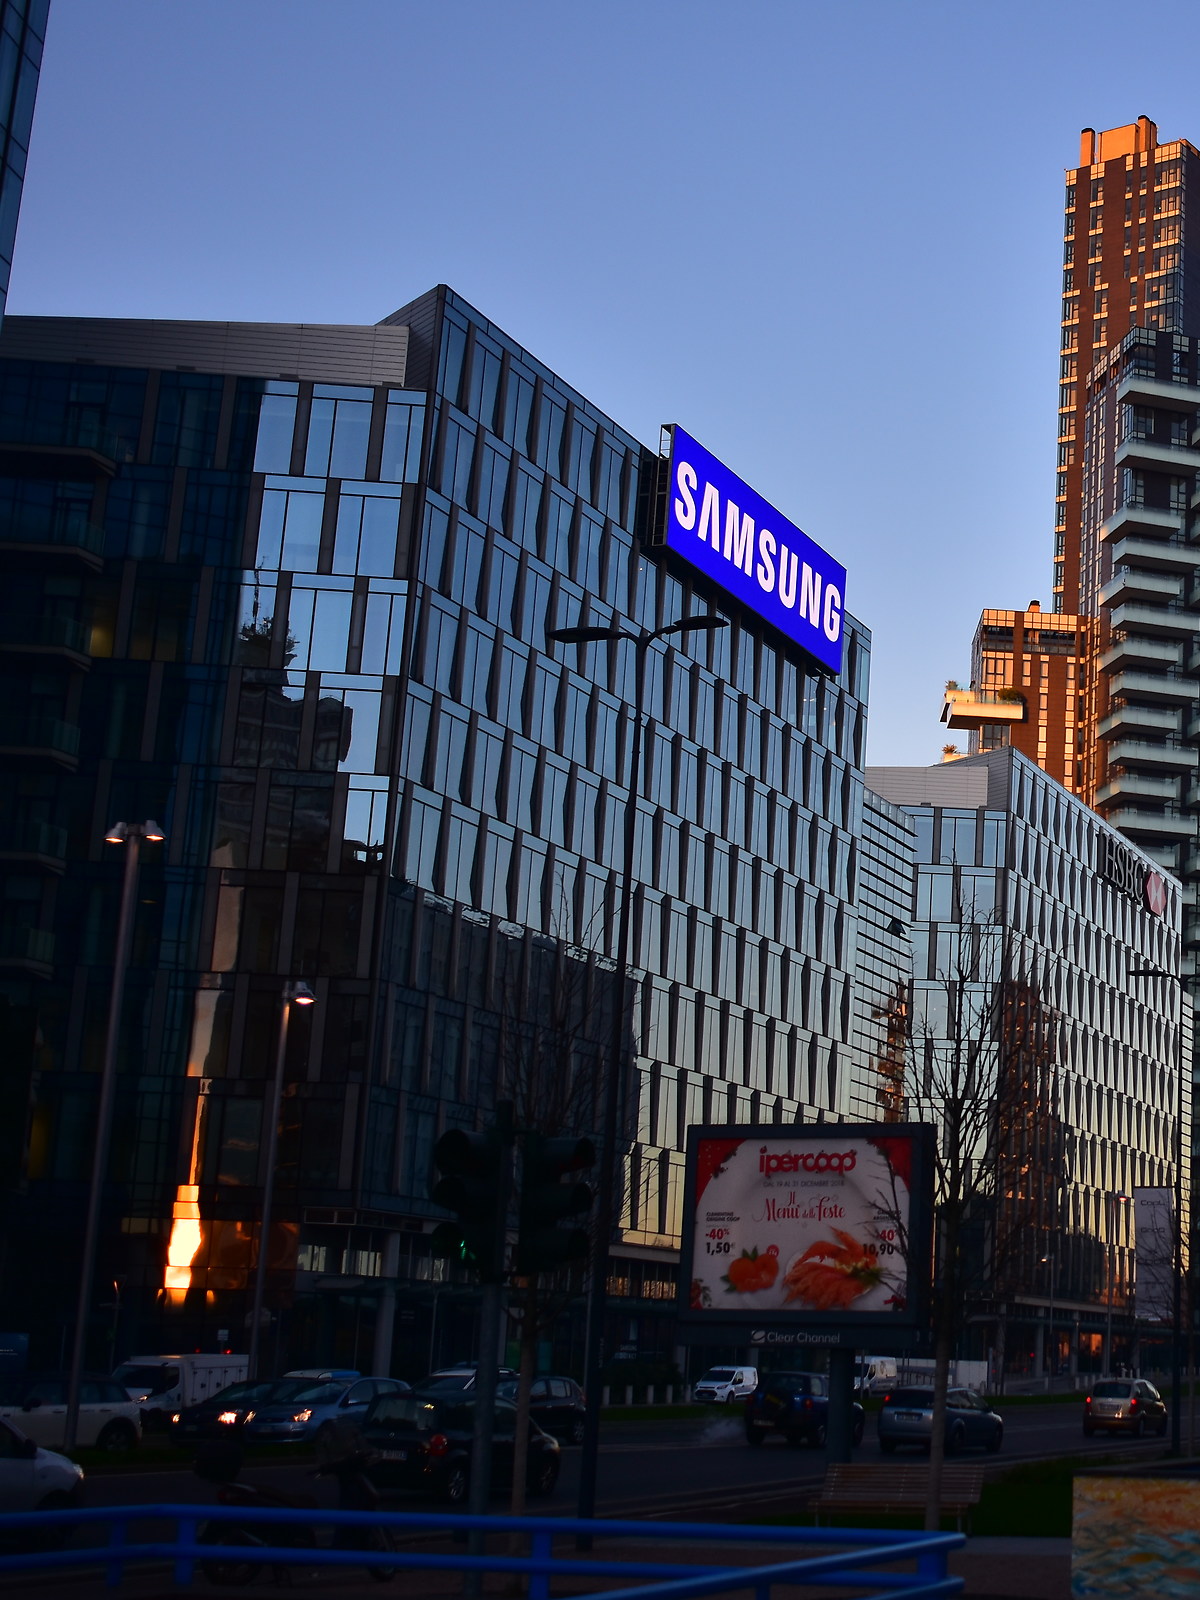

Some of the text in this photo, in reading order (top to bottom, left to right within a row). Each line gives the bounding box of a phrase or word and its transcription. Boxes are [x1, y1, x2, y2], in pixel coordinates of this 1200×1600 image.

[674, 461, 842, 643] SAMSUNG
[1102, 833, 1145, 902] HSBC
[759, 1147, 856, 1178] ipercoop
[767, 1331, 841, 1344] Clear Channel
